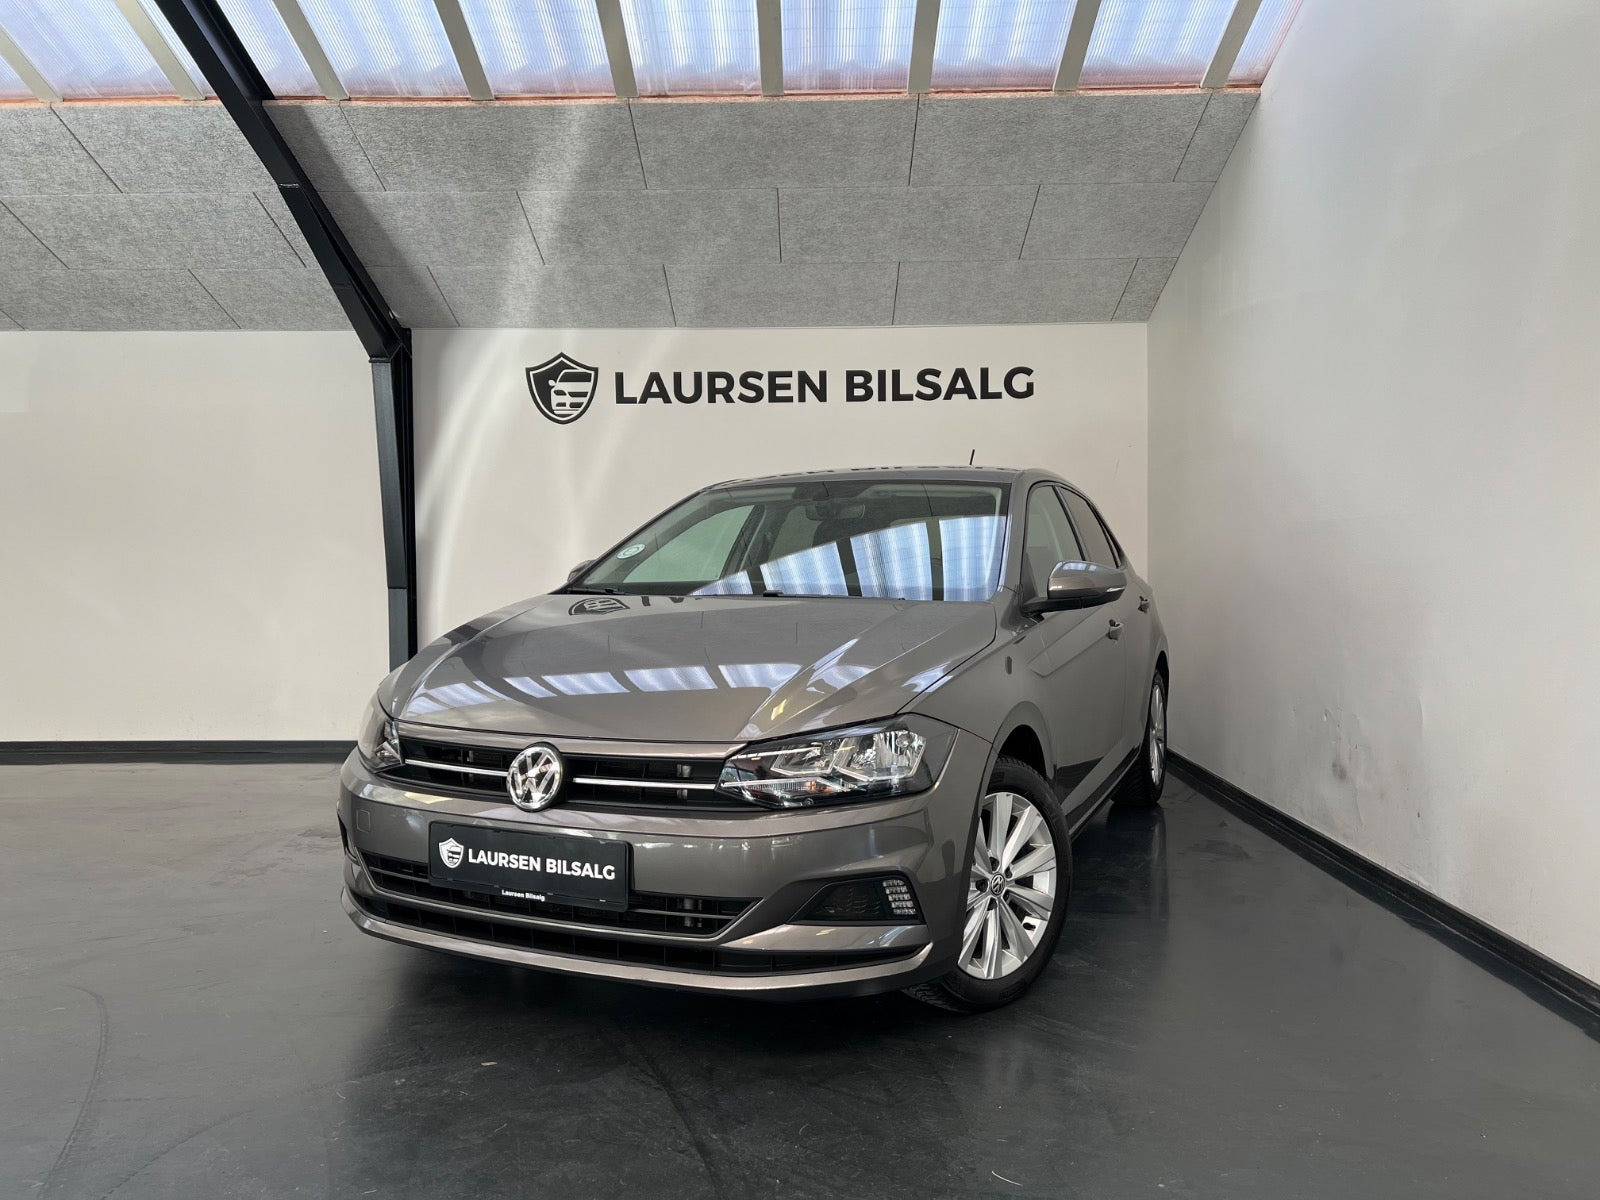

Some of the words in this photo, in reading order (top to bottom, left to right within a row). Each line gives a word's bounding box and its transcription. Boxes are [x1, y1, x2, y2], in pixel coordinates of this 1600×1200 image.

[615, 371, 827, 405] LAURSEN
[846, 366, 1034, 403] BILSALG
[468, 848, 541, 872] LAURSEN
[546, 858, 616, 880] BILSALG
[501, 889, 525, 899] Laursen
[525, 891, 546, 902] Bilsalg
